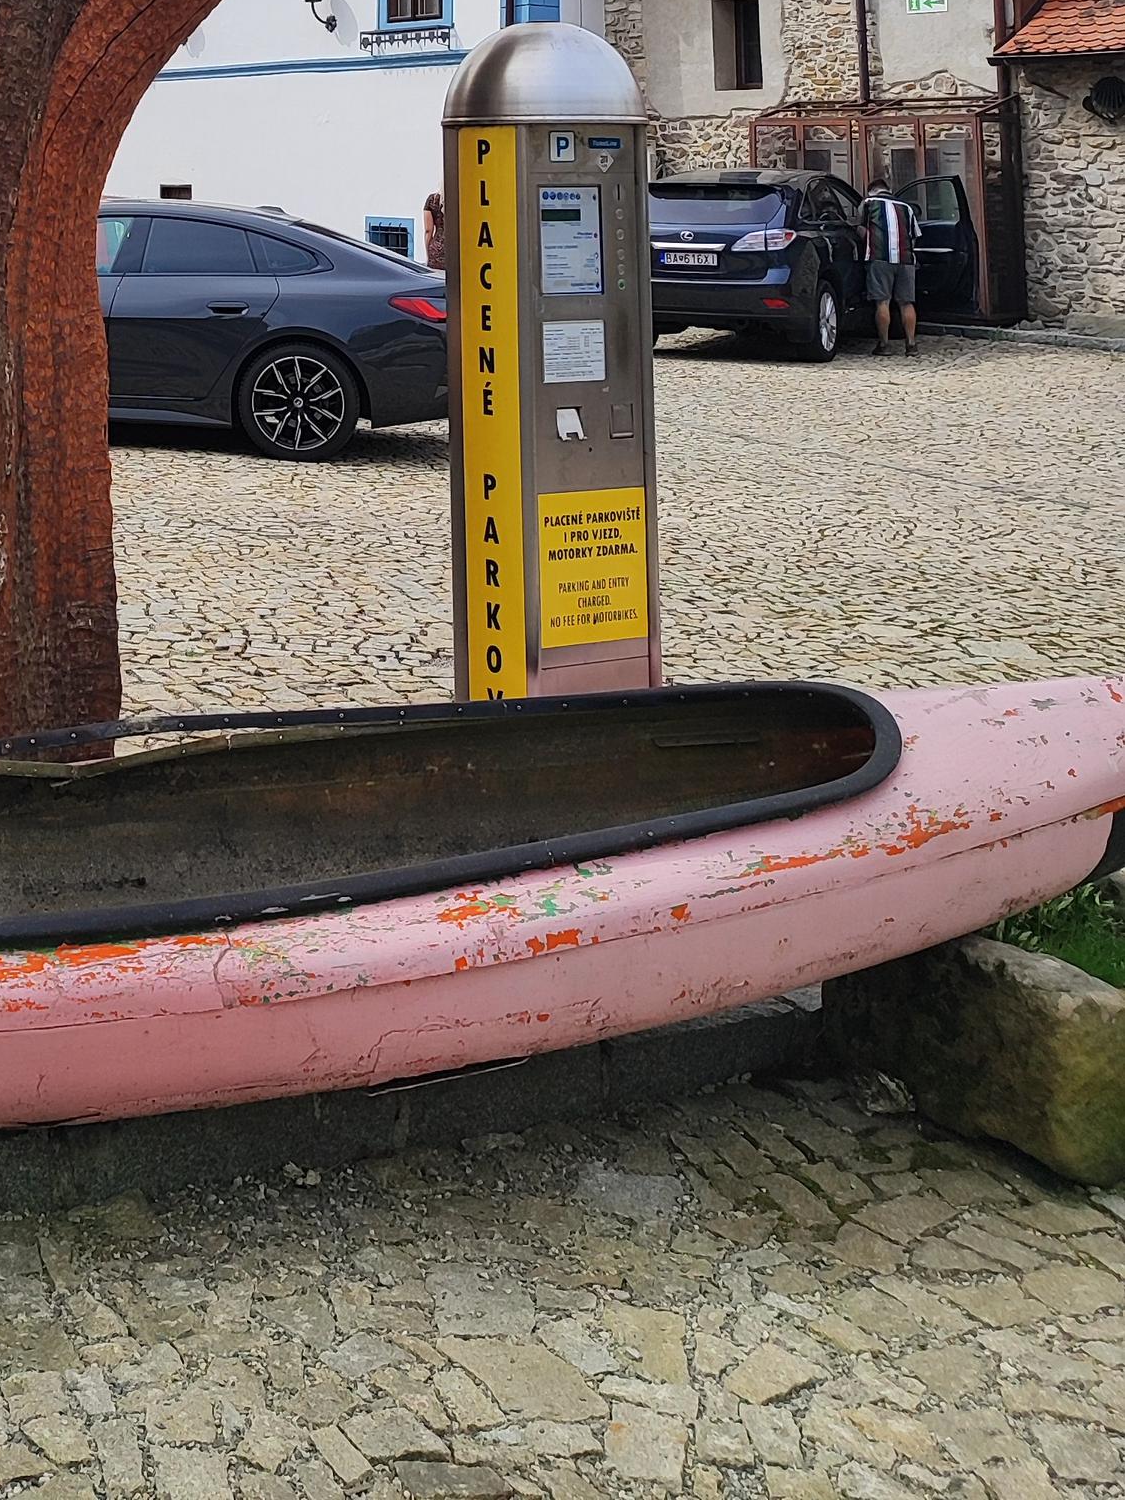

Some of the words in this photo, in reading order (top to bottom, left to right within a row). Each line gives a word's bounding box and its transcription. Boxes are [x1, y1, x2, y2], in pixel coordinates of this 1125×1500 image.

[556, 136, 570, 158] P
[477, 139, 495, 416] PLACENÉ
[544, 511, 583, 528] PLACENÉ
[586, 506, 640, 524] PARKOVIŠTĚ
[563, 532, 568, 543] I
[570, 530, 589, 542] PRO
[592, 528, 622, 540] VJEZD,
[548, 546, 593, 561] MOTORKY
[596, 543, 638, 557] ZDARMA.
[558, 580, 589, 594] PARKING
[591, 578, 606, 590] AND
[608, 576, 629, 589] ENTRY
[577, 595, 612, 608] CHARGED.
[550, 616, 561, 628] NO
[563, 614, 575, 627] FEE
[577, 613, 591, 626] FOR
[593, 608, 638, 624] MOTORBIKES.
